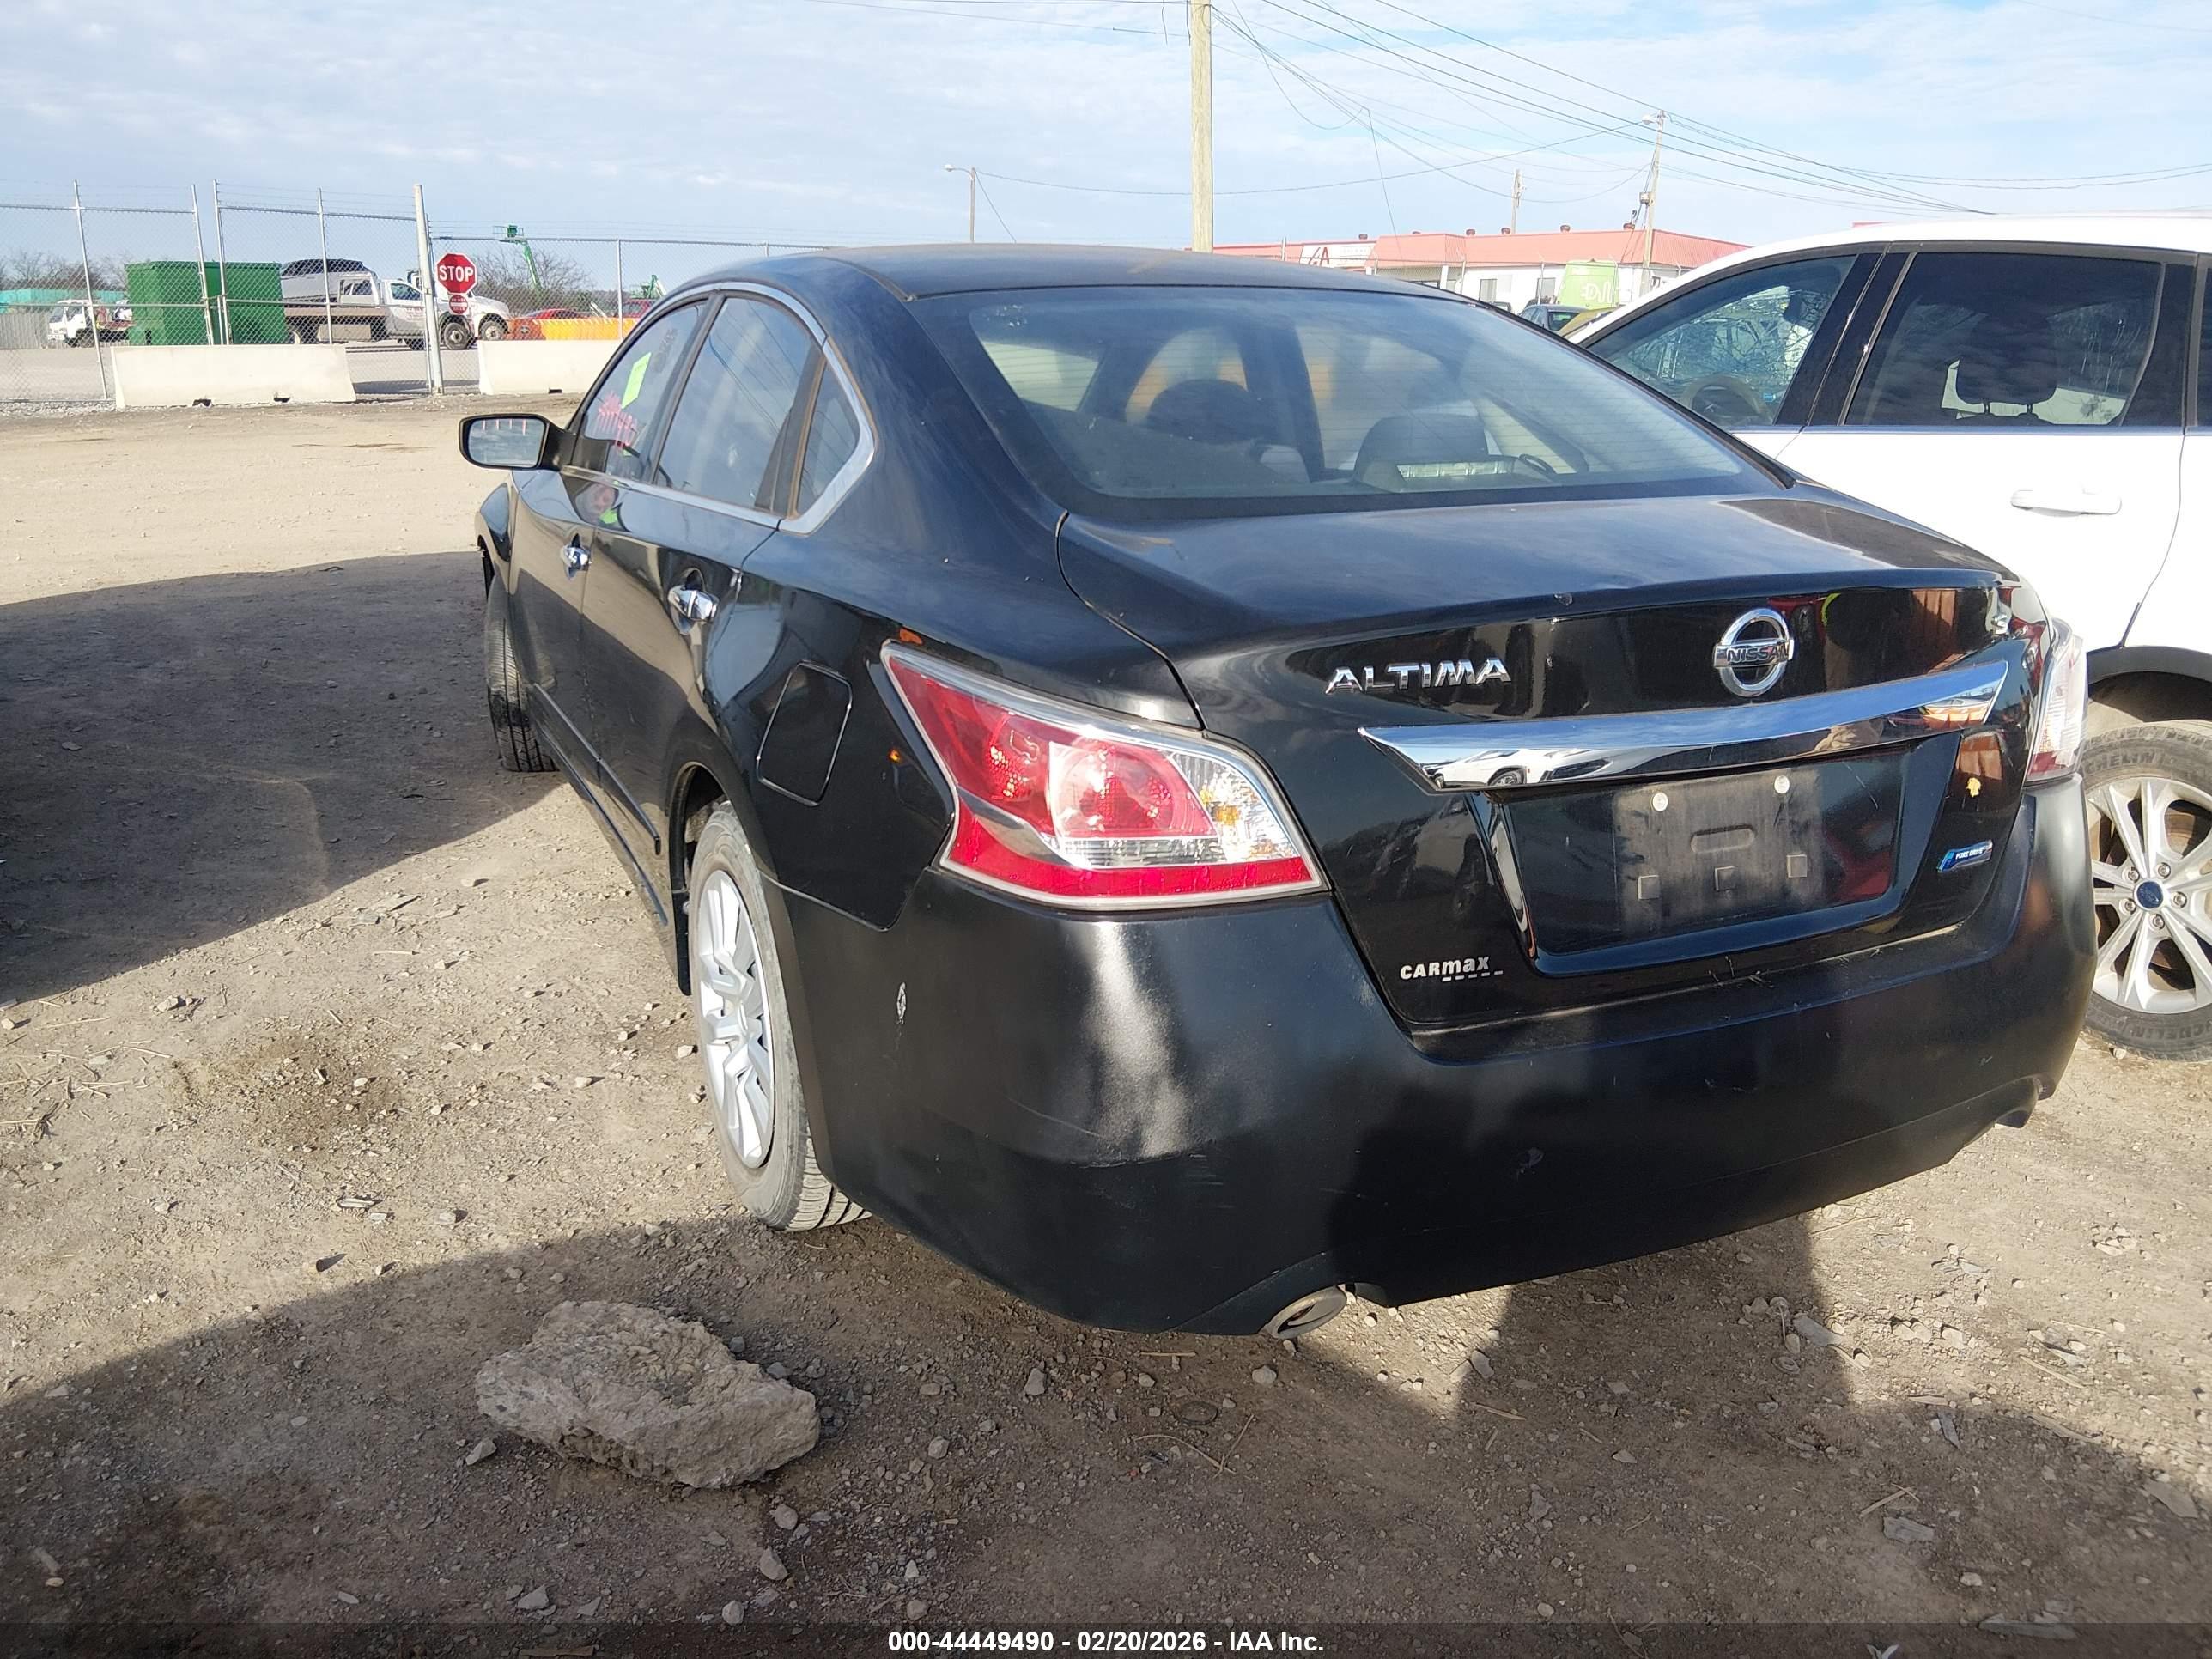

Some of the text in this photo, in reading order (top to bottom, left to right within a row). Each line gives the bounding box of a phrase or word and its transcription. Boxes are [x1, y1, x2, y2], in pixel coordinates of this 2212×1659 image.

[439, 264, 474, 283] STOP
[1727, 641, 1790, 663] NISSAN
[1325, 657, 1511, 695] ALTIMA
